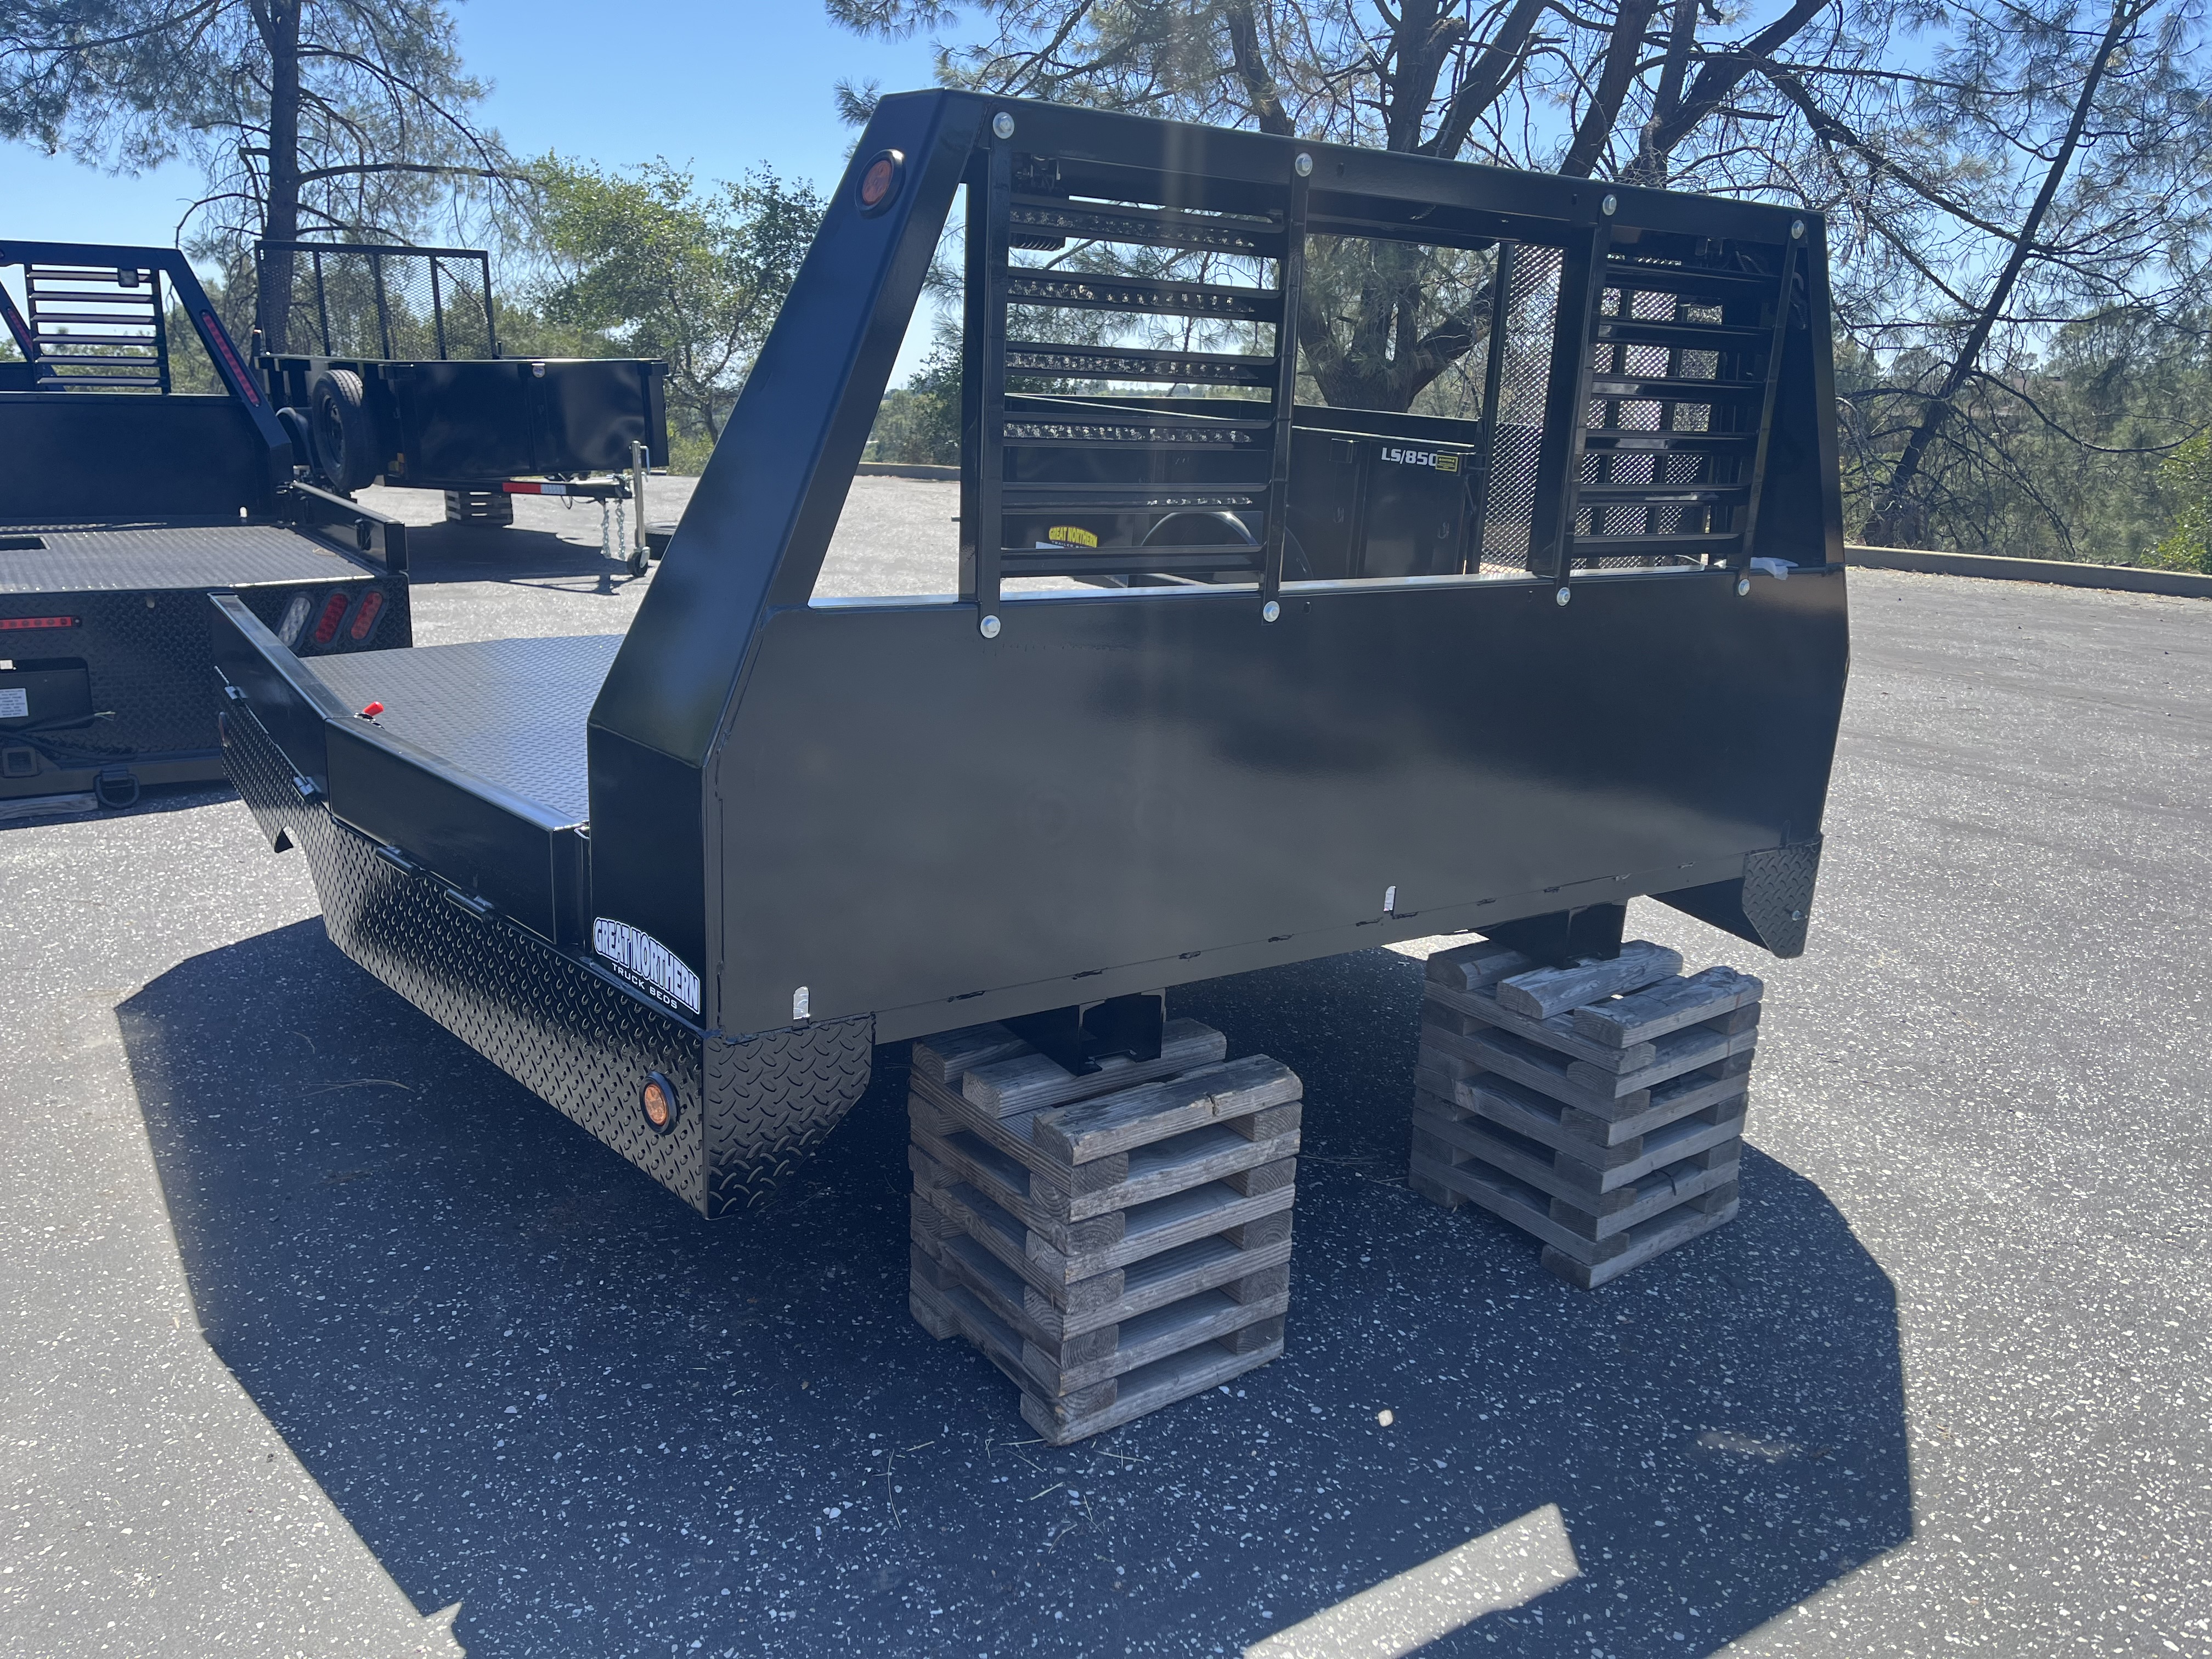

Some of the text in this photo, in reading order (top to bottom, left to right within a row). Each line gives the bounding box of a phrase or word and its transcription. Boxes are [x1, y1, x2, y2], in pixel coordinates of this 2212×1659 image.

[1049, 527, 1098, 548] GREAT NORTHERN
[594, 917, 700, 1014] GREAT NORTHERN
[612, 962, 678, 1009] TRUCK BEDS
